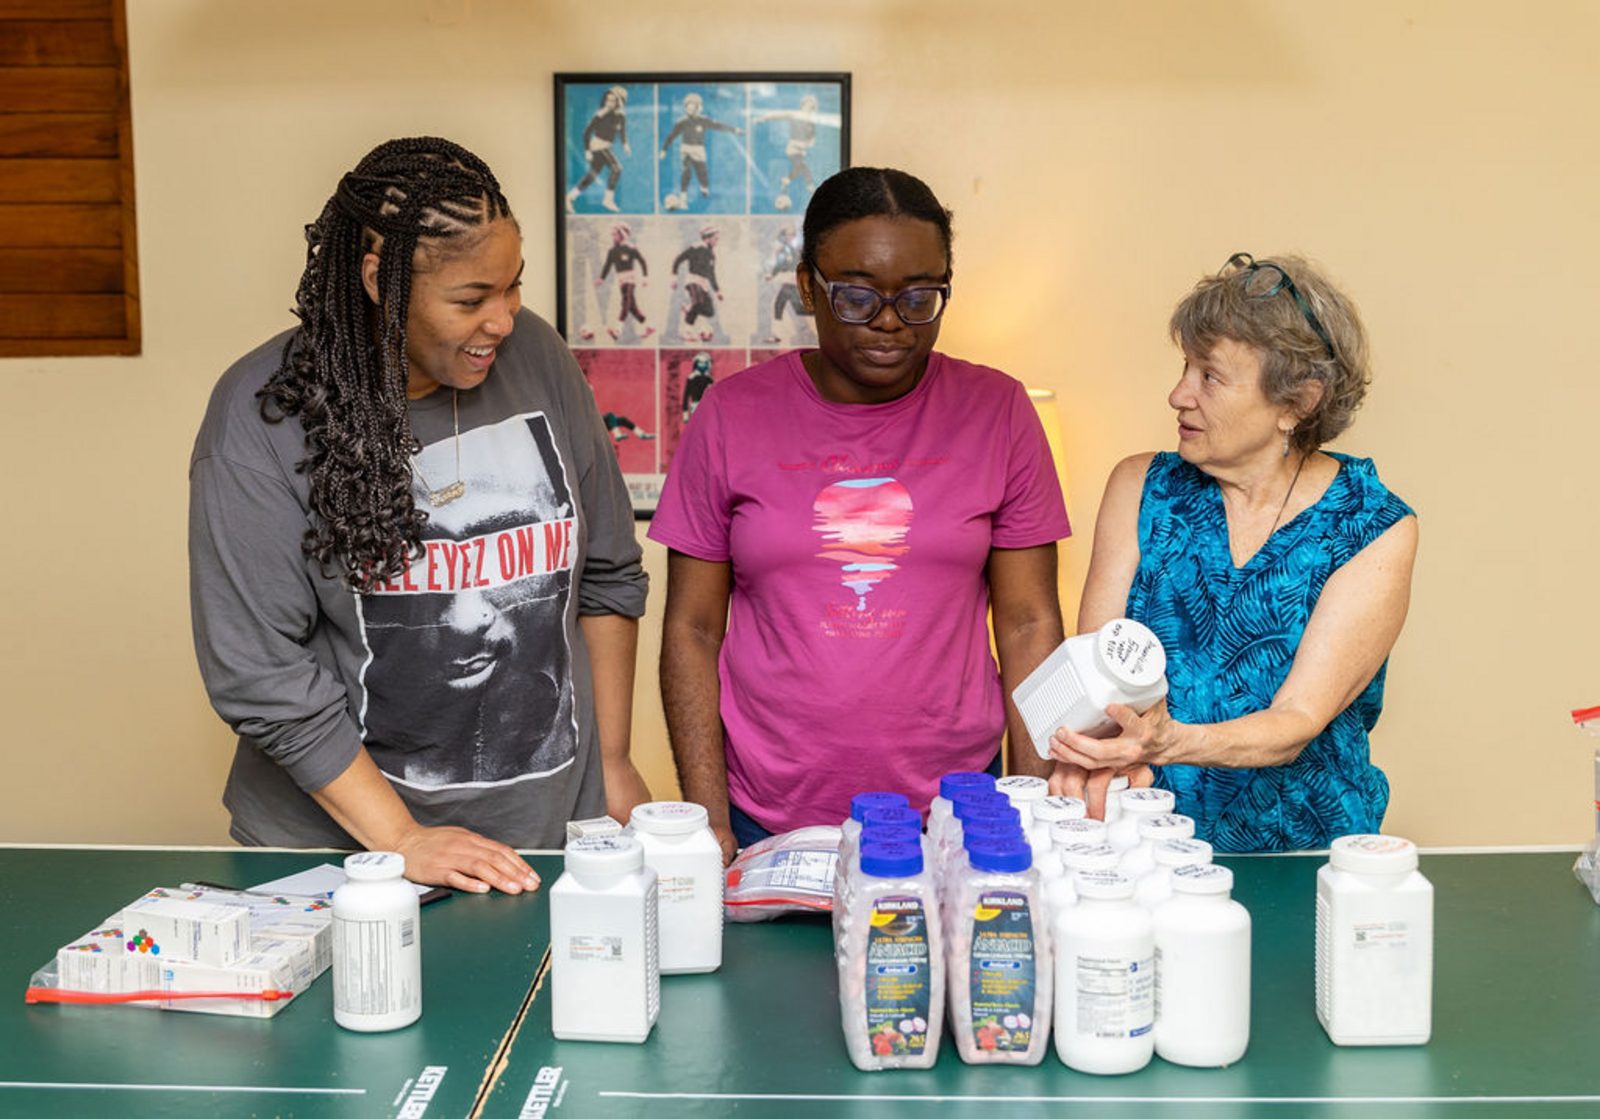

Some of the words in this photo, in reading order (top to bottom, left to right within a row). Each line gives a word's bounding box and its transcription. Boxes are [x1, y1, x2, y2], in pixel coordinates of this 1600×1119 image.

[426, 537, 490, 592] EYEZ
[497, 527, 534, 580] ON
[543, 520, 573, 573] ME
